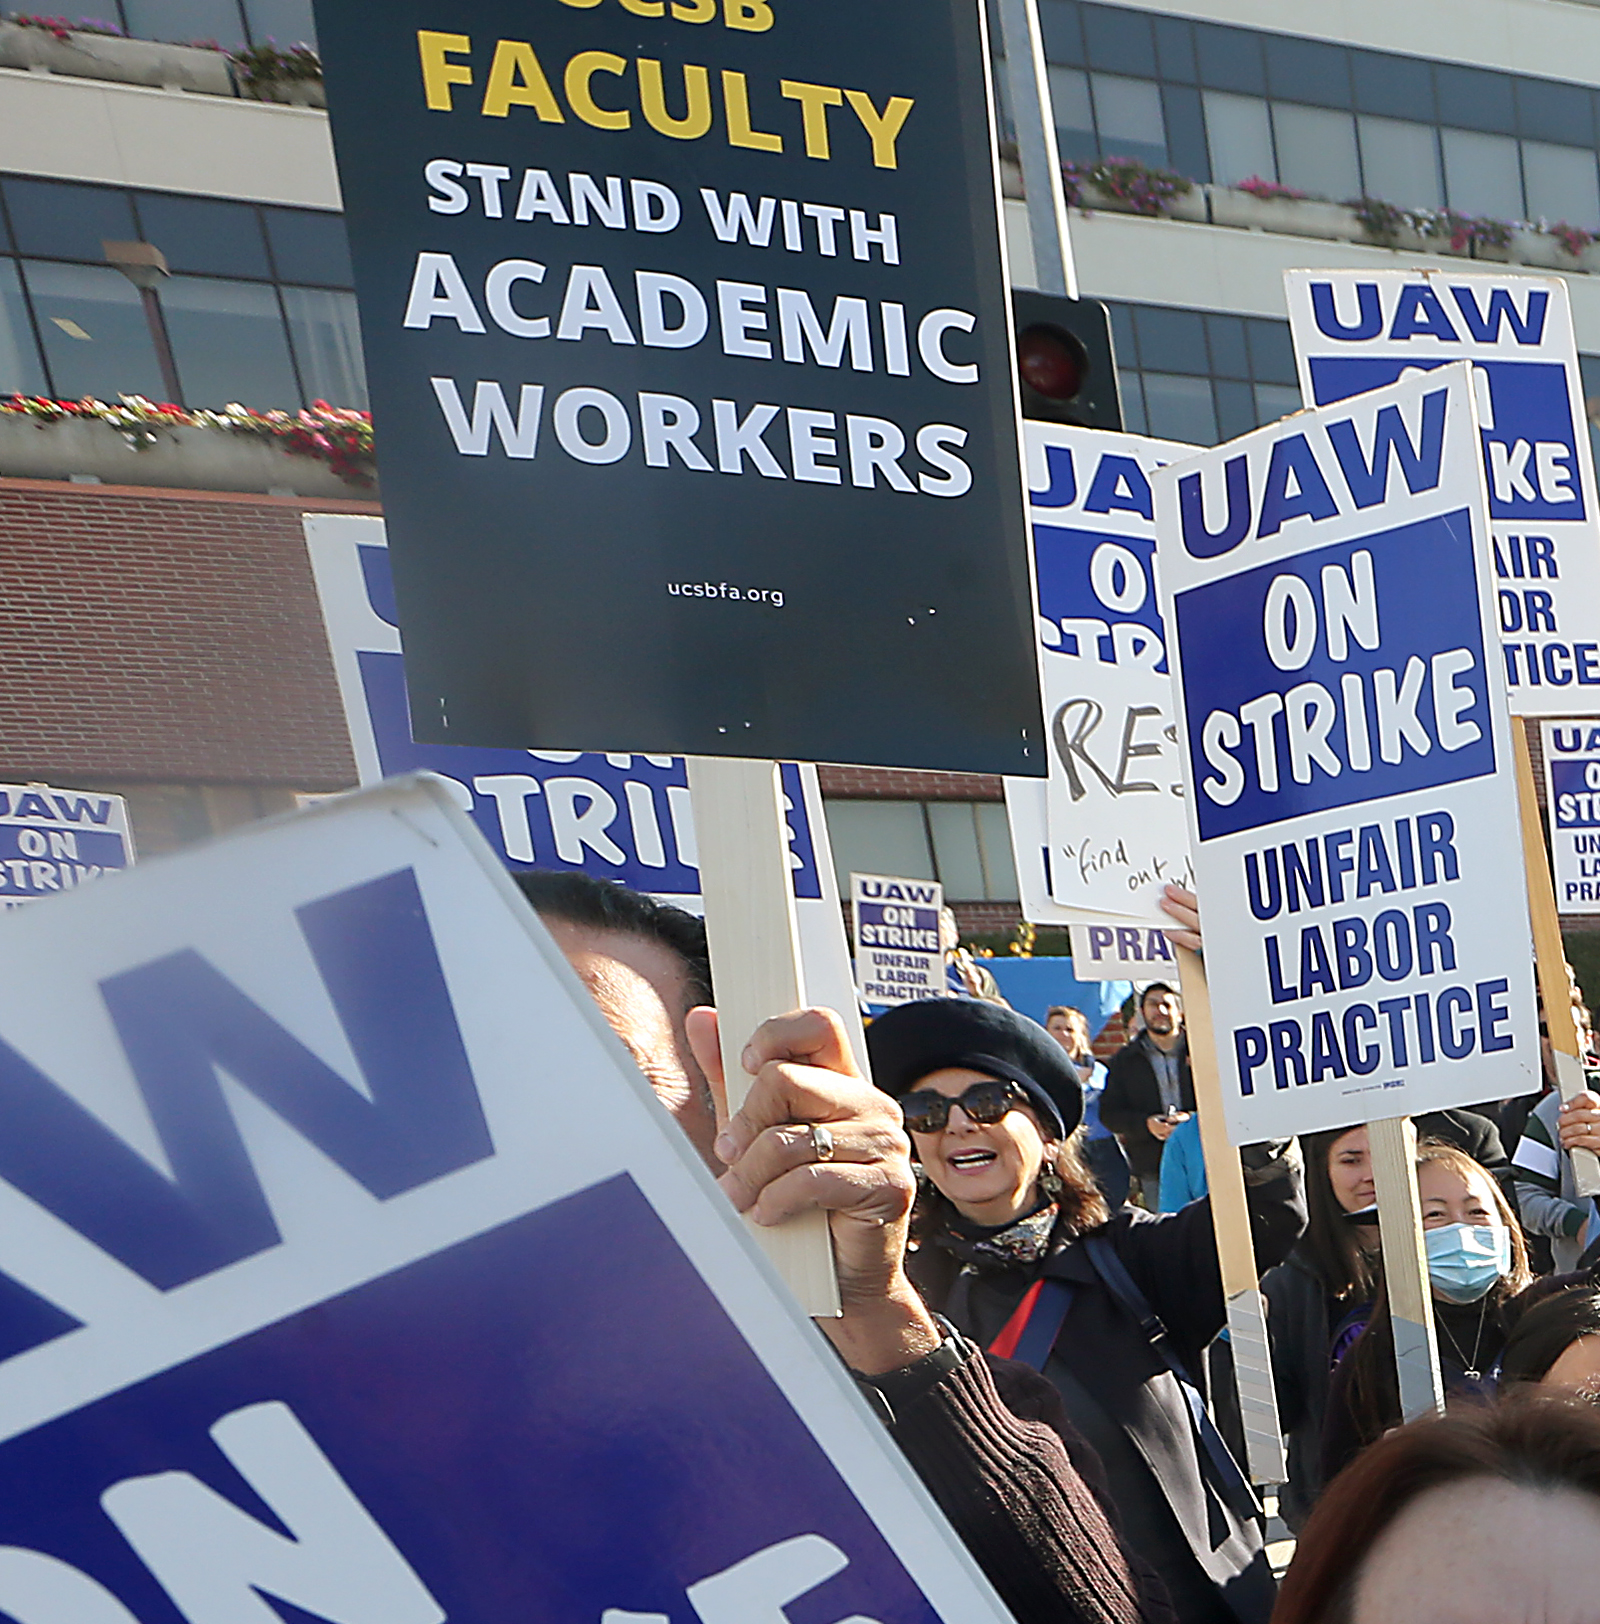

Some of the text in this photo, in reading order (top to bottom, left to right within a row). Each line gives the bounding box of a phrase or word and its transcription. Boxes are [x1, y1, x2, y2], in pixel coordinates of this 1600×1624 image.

[415, 29, 914, 170] FACULTY
[424, 157, 901, 267] STAND WITH
[403, 252, 981, 385] ACADEMIC
[1310, 282, 1550, 346] UAW
[430, 377, 975, 499] WORKERS
[1175, 386, 1451, 561] UAW
[667, 581, 784, 608] ucsbfa.org
[1264, 549, 1381, 671] ON
[1203, 647, 1483, 806] STRIKE
[18, 829, 79, 861] ON
[861, 880, 936, 902] UAW
[1243, 809, 1461, 921] UNFAIR
[861, 923, 939, 949] STRIKE
[872, 952, 930, 970] UNFAIR
[882, 906, 915, 928] ON
[1263, 902, 1458, 1006] LABOR
[875, 969, 928, 985] LABOR
[1233, 978, 1516, 1098] PRACTICE
